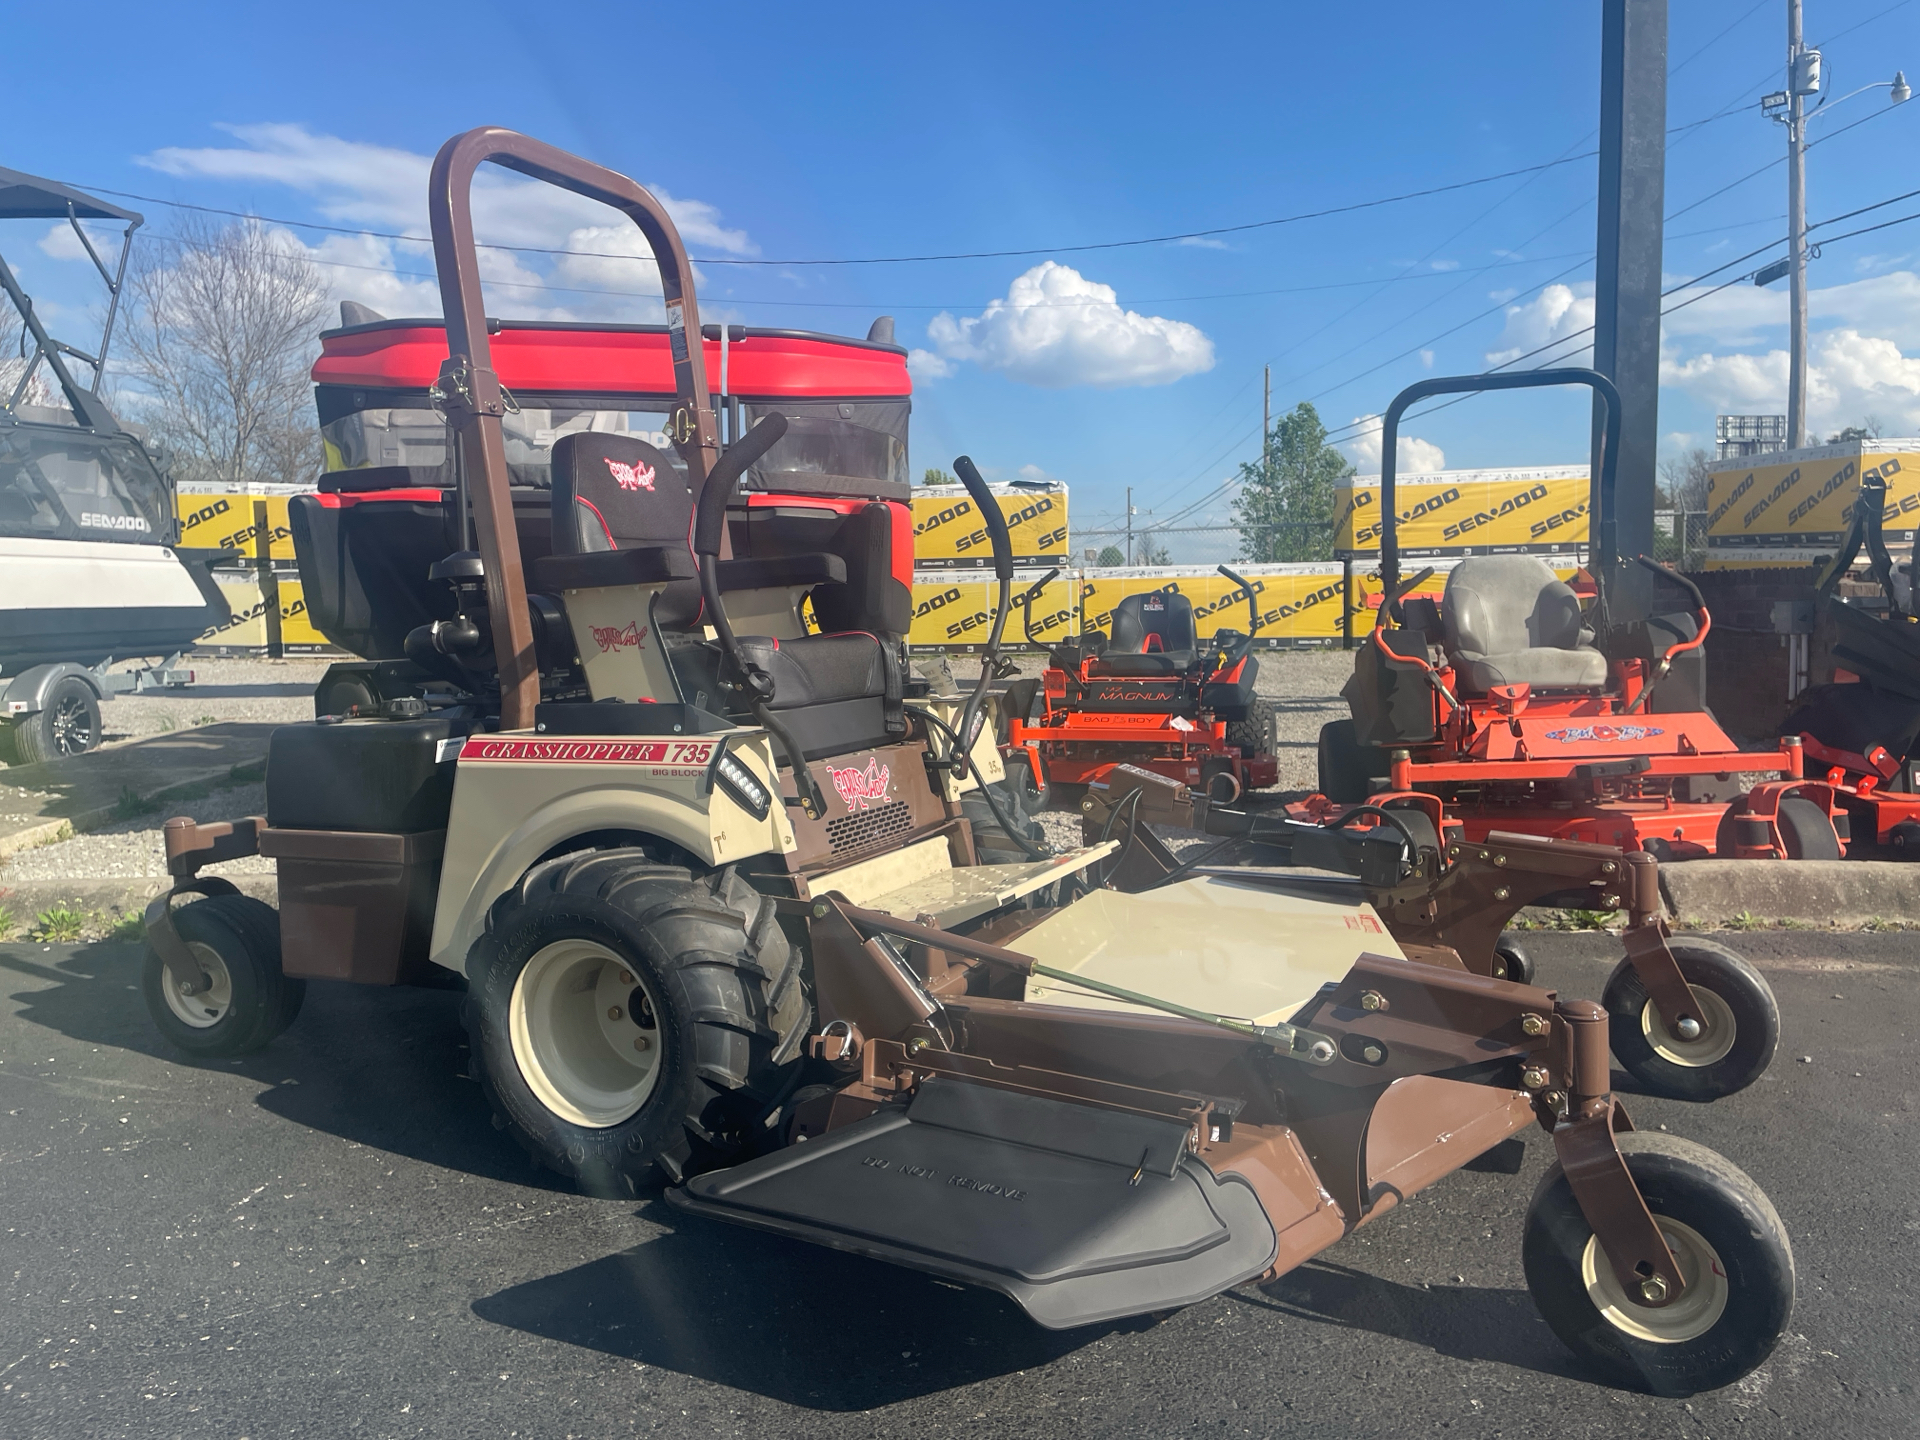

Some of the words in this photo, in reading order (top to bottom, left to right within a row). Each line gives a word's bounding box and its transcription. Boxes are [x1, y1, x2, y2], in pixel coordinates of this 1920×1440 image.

[1098, 692, 1175, 701] MAGNUM
[671, 743, 712, 763] 735
[652, 768, 669, 777] BIG
[670, 769, 706, 778] BLOCK
[861, 1156, 890, 1169] DO
[898, 1164, 940, 1180] NOT
[947, 1174, 1029, 1202] REMOVE
